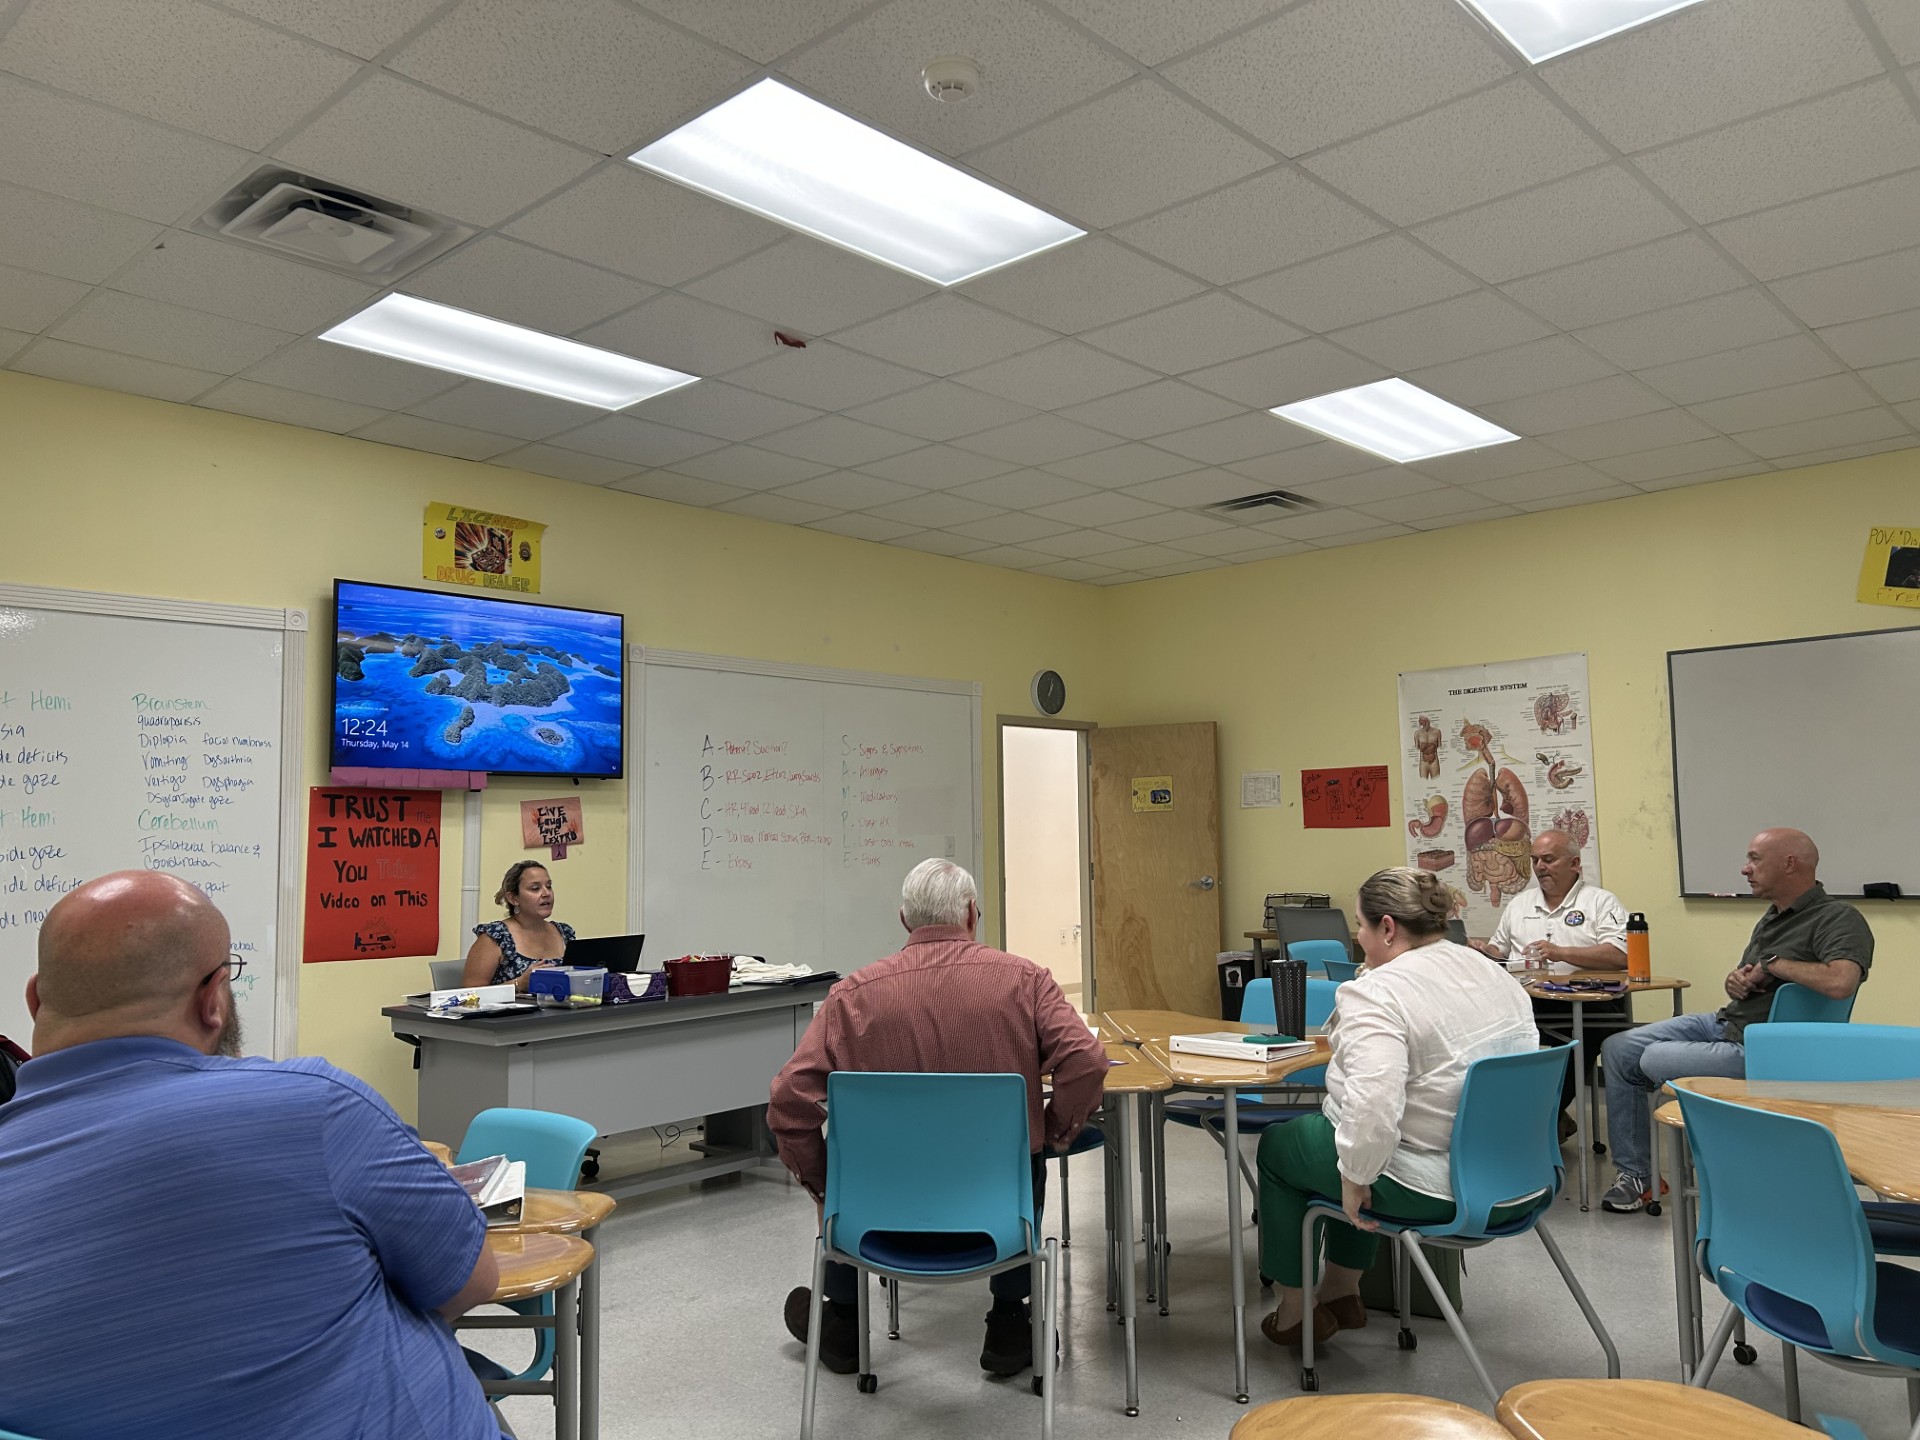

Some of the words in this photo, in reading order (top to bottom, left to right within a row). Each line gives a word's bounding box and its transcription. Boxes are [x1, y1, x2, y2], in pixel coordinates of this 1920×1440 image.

[436, 565, 475, 585] DRUG
[482, 573, 530, 592] DEALER
[31, 689, 71, 712] Hemi
[1448, 689, 1462, 697] THE
[1463, 685, 1498, 696] DIGESTIVE
[1499, 683, 1528, 692] SYSTEM
[131, 692, 211, 714] Brainstem
[341, 717, 388, 737] 12:24
[138, 733, 187, 749] Diplopia
[341, 738, 380, 750] Thursday,
[382, 740, 399, 750] May
[401, 741, 409, 749] 14
[701, 734, 714, 757] A
[141, 751, 190, 771] Vomiting
[22, 773, 60, 794] gaze
[144, 774, 187, 792] Vertigo
[700, 764, 714, 791] B
[22, 806, 56, 828] Hemi
[321, 793, 412, 823] TRUST
[700, 797, 711, 820] C
[138, 808, 221, 834] Cerebellum
[317, 827, 337, 848] I
[348, 826, 421, 848] WATCHED
[424, 827, 438, 848] A
[701, 826, 714, 848] D
[28, 844, 67, 870] gaze
[701, 850, 711, 870] E
[205, 881, 230, 899] gait
[320, 891, 360, 909] Video
[370, 894, 386, 907] on
[394, 889, 428, 907] This
